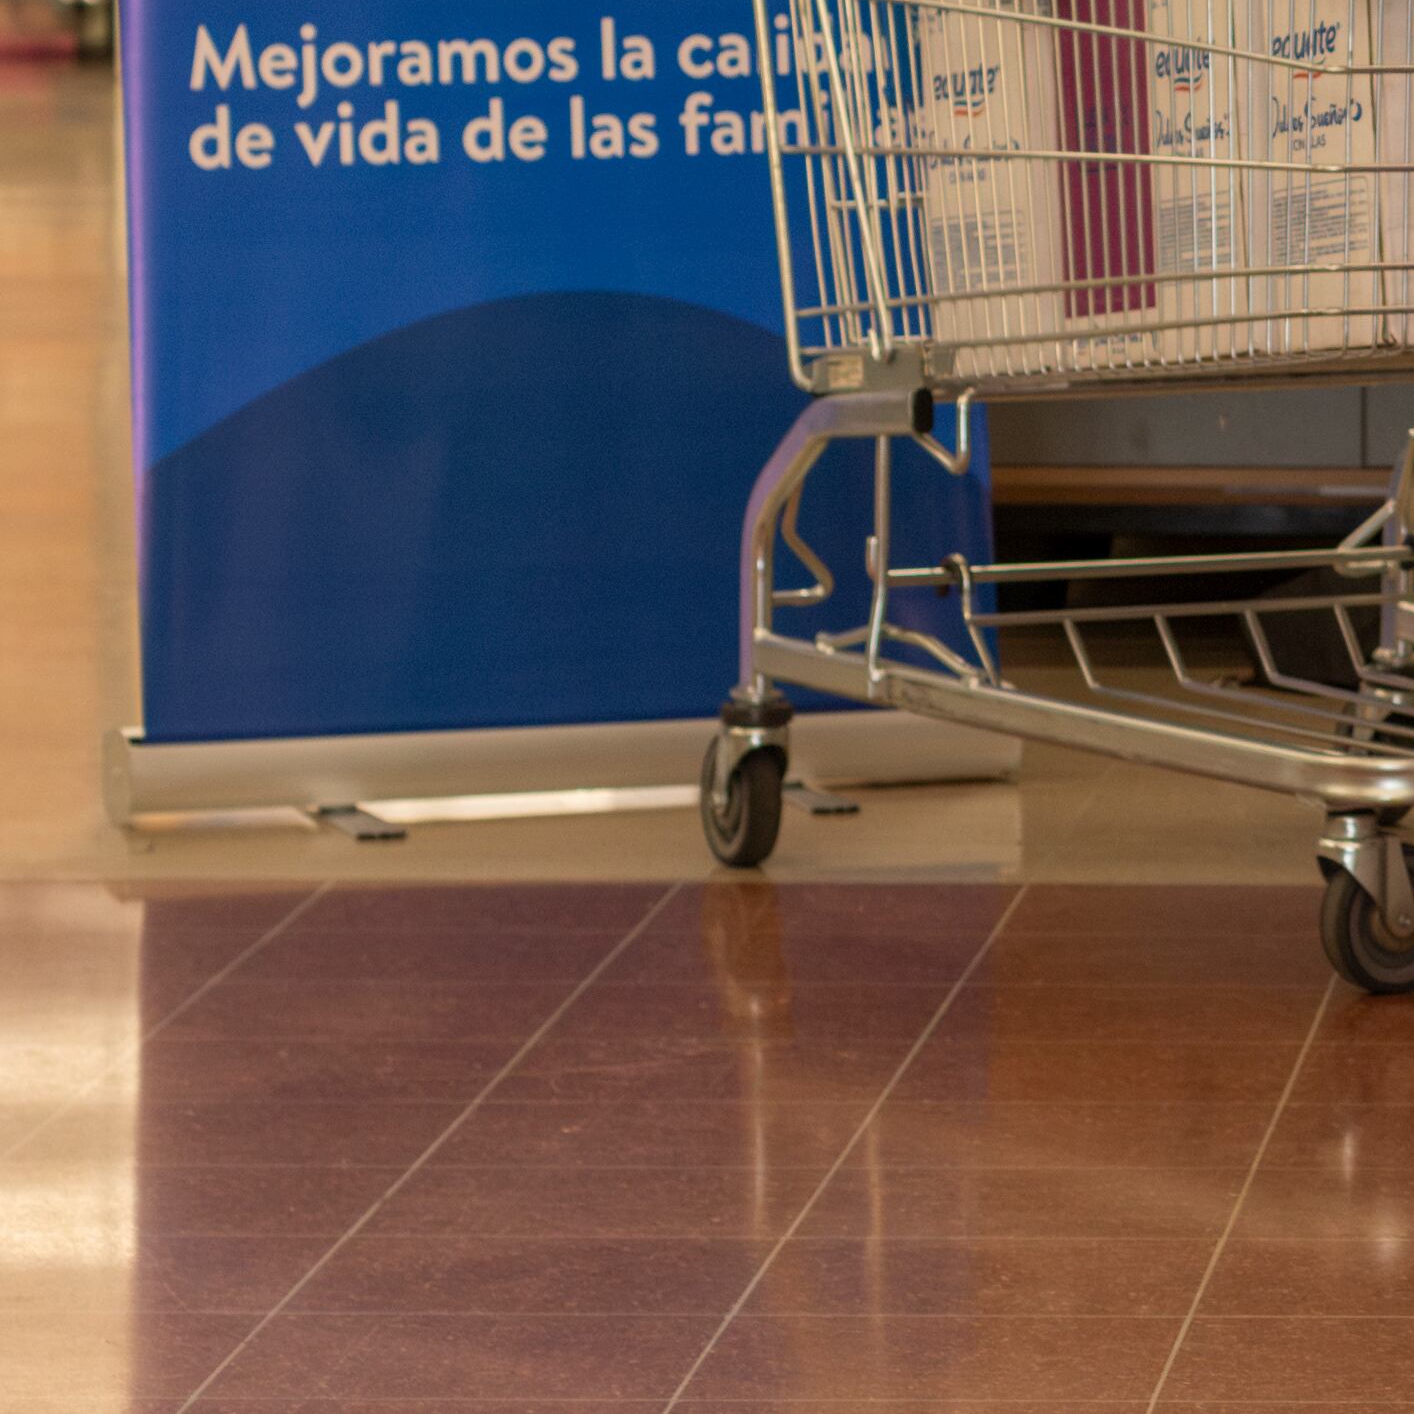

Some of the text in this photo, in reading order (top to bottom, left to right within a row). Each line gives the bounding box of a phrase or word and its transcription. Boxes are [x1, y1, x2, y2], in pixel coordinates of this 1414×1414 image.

[189, 17, 656, 107] Mejoramos la
[189, 95, 660, 170] de vida de las
